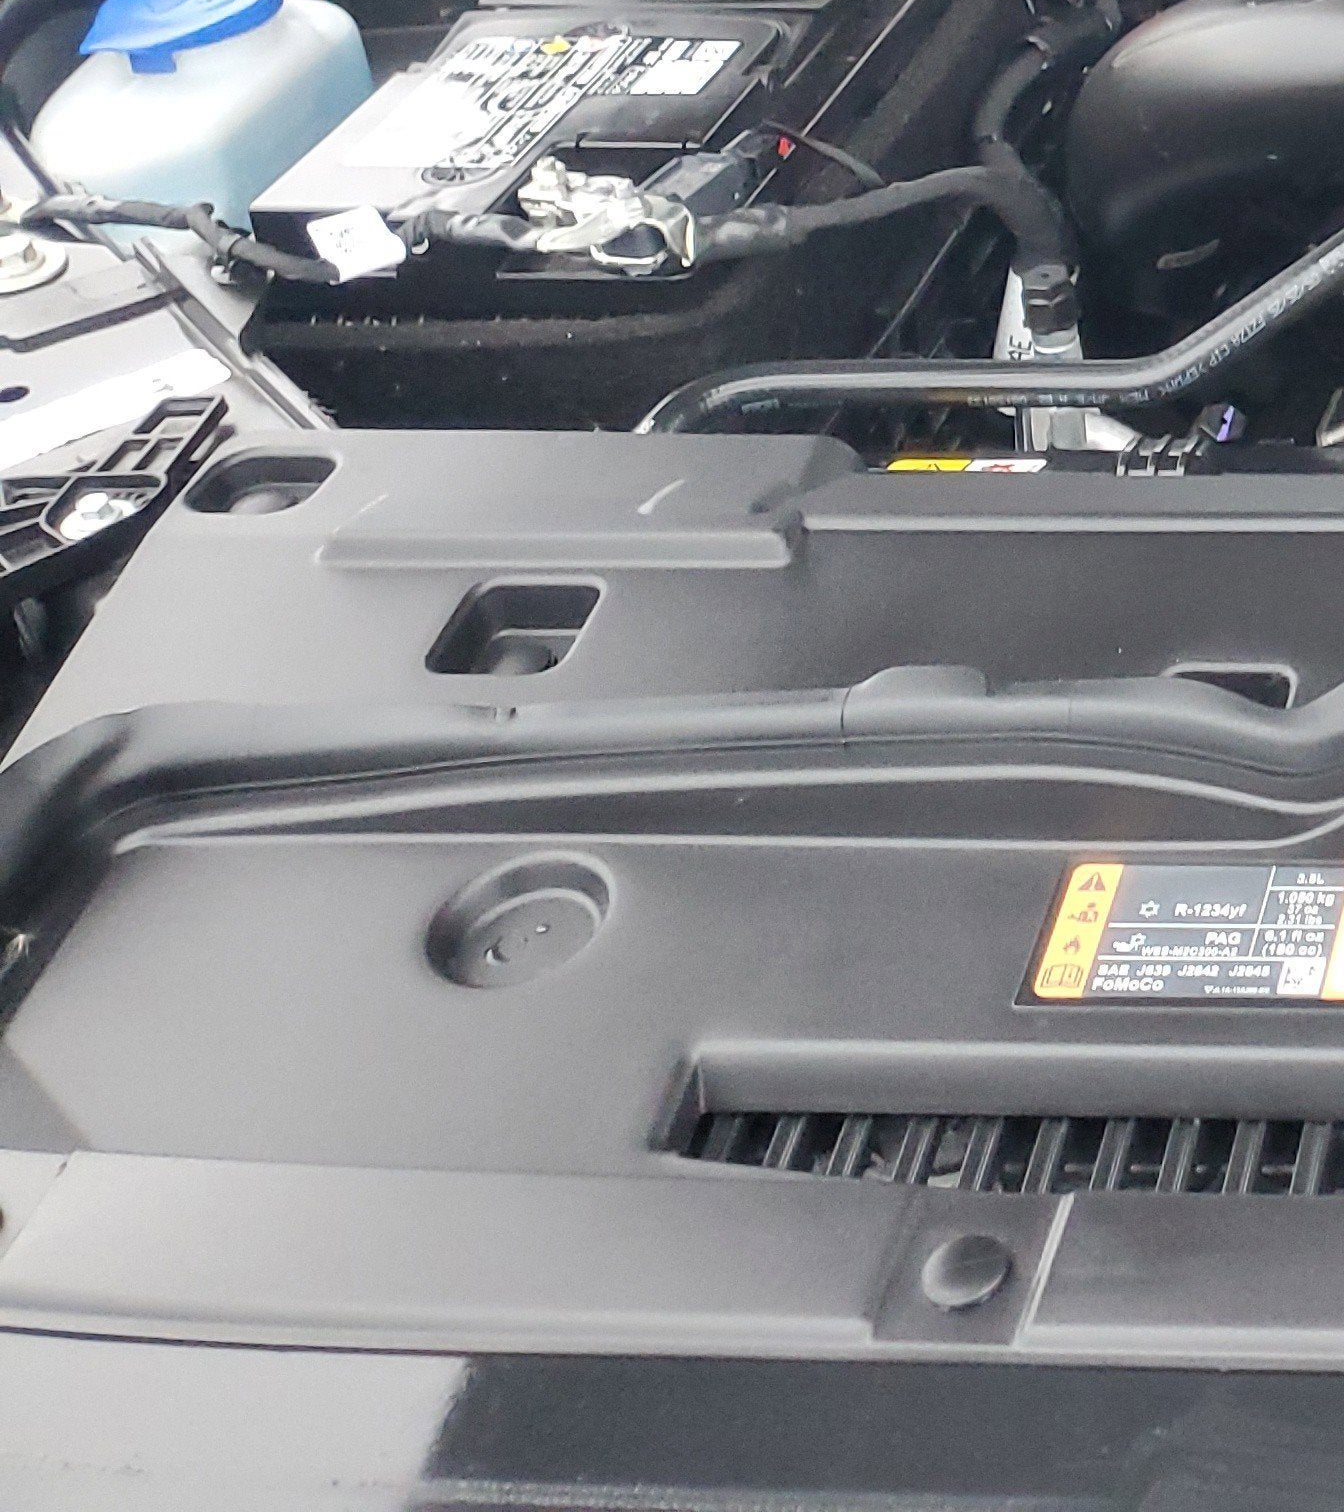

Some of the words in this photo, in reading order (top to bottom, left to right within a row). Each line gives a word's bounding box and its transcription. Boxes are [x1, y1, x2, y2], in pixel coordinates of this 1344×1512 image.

[1316, 891, 1336, 907] kg
[1174, 902, 1248, 920] R-1234yf
[1287, 903, 1303, 915] 37
[1204, 931, 1242, 945] PAG
[1097, 964, 1131, 976] SAE
[1091, 976, 1165, 992] FoMoCo
